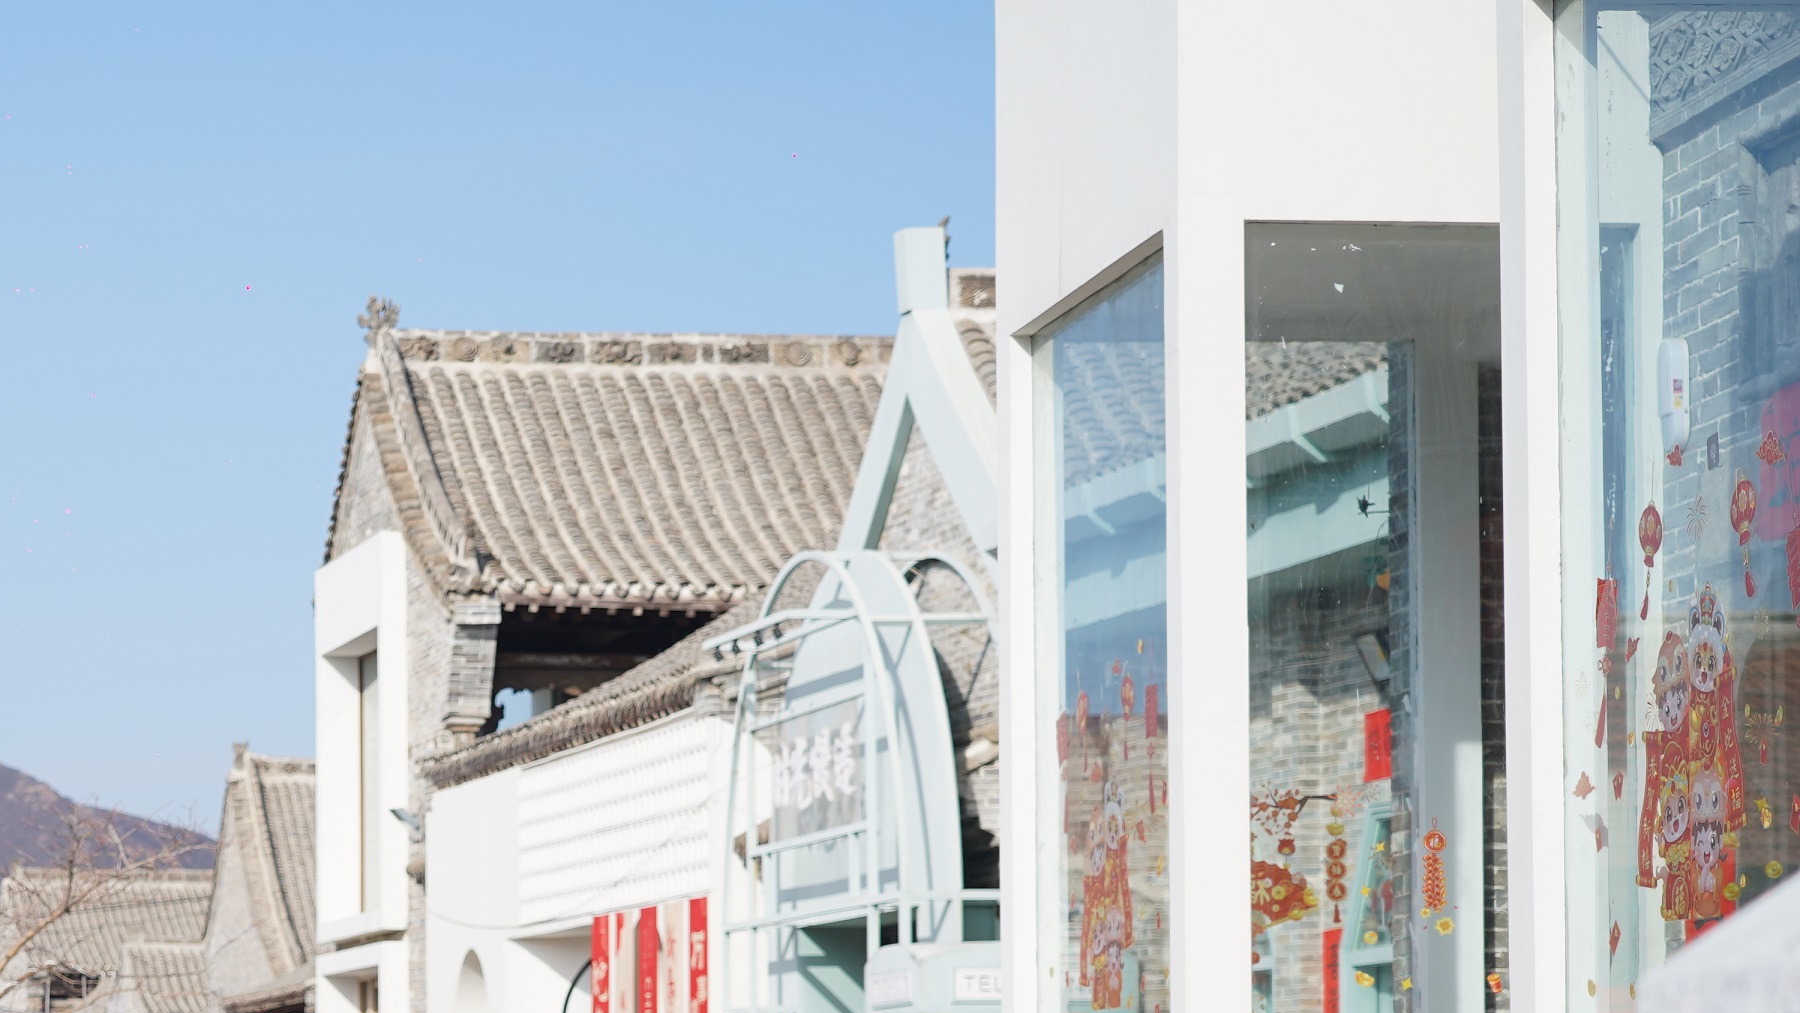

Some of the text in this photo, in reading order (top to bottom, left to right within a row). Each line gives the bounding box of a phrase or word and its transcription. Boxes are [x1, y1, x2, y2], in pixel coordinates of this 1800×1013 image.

[1720, 696, 1742, 810] 金蛇送福
[1640, 753, 1659, 870] 恭贺新禧
[1674, 883, 1687, 917] 福
